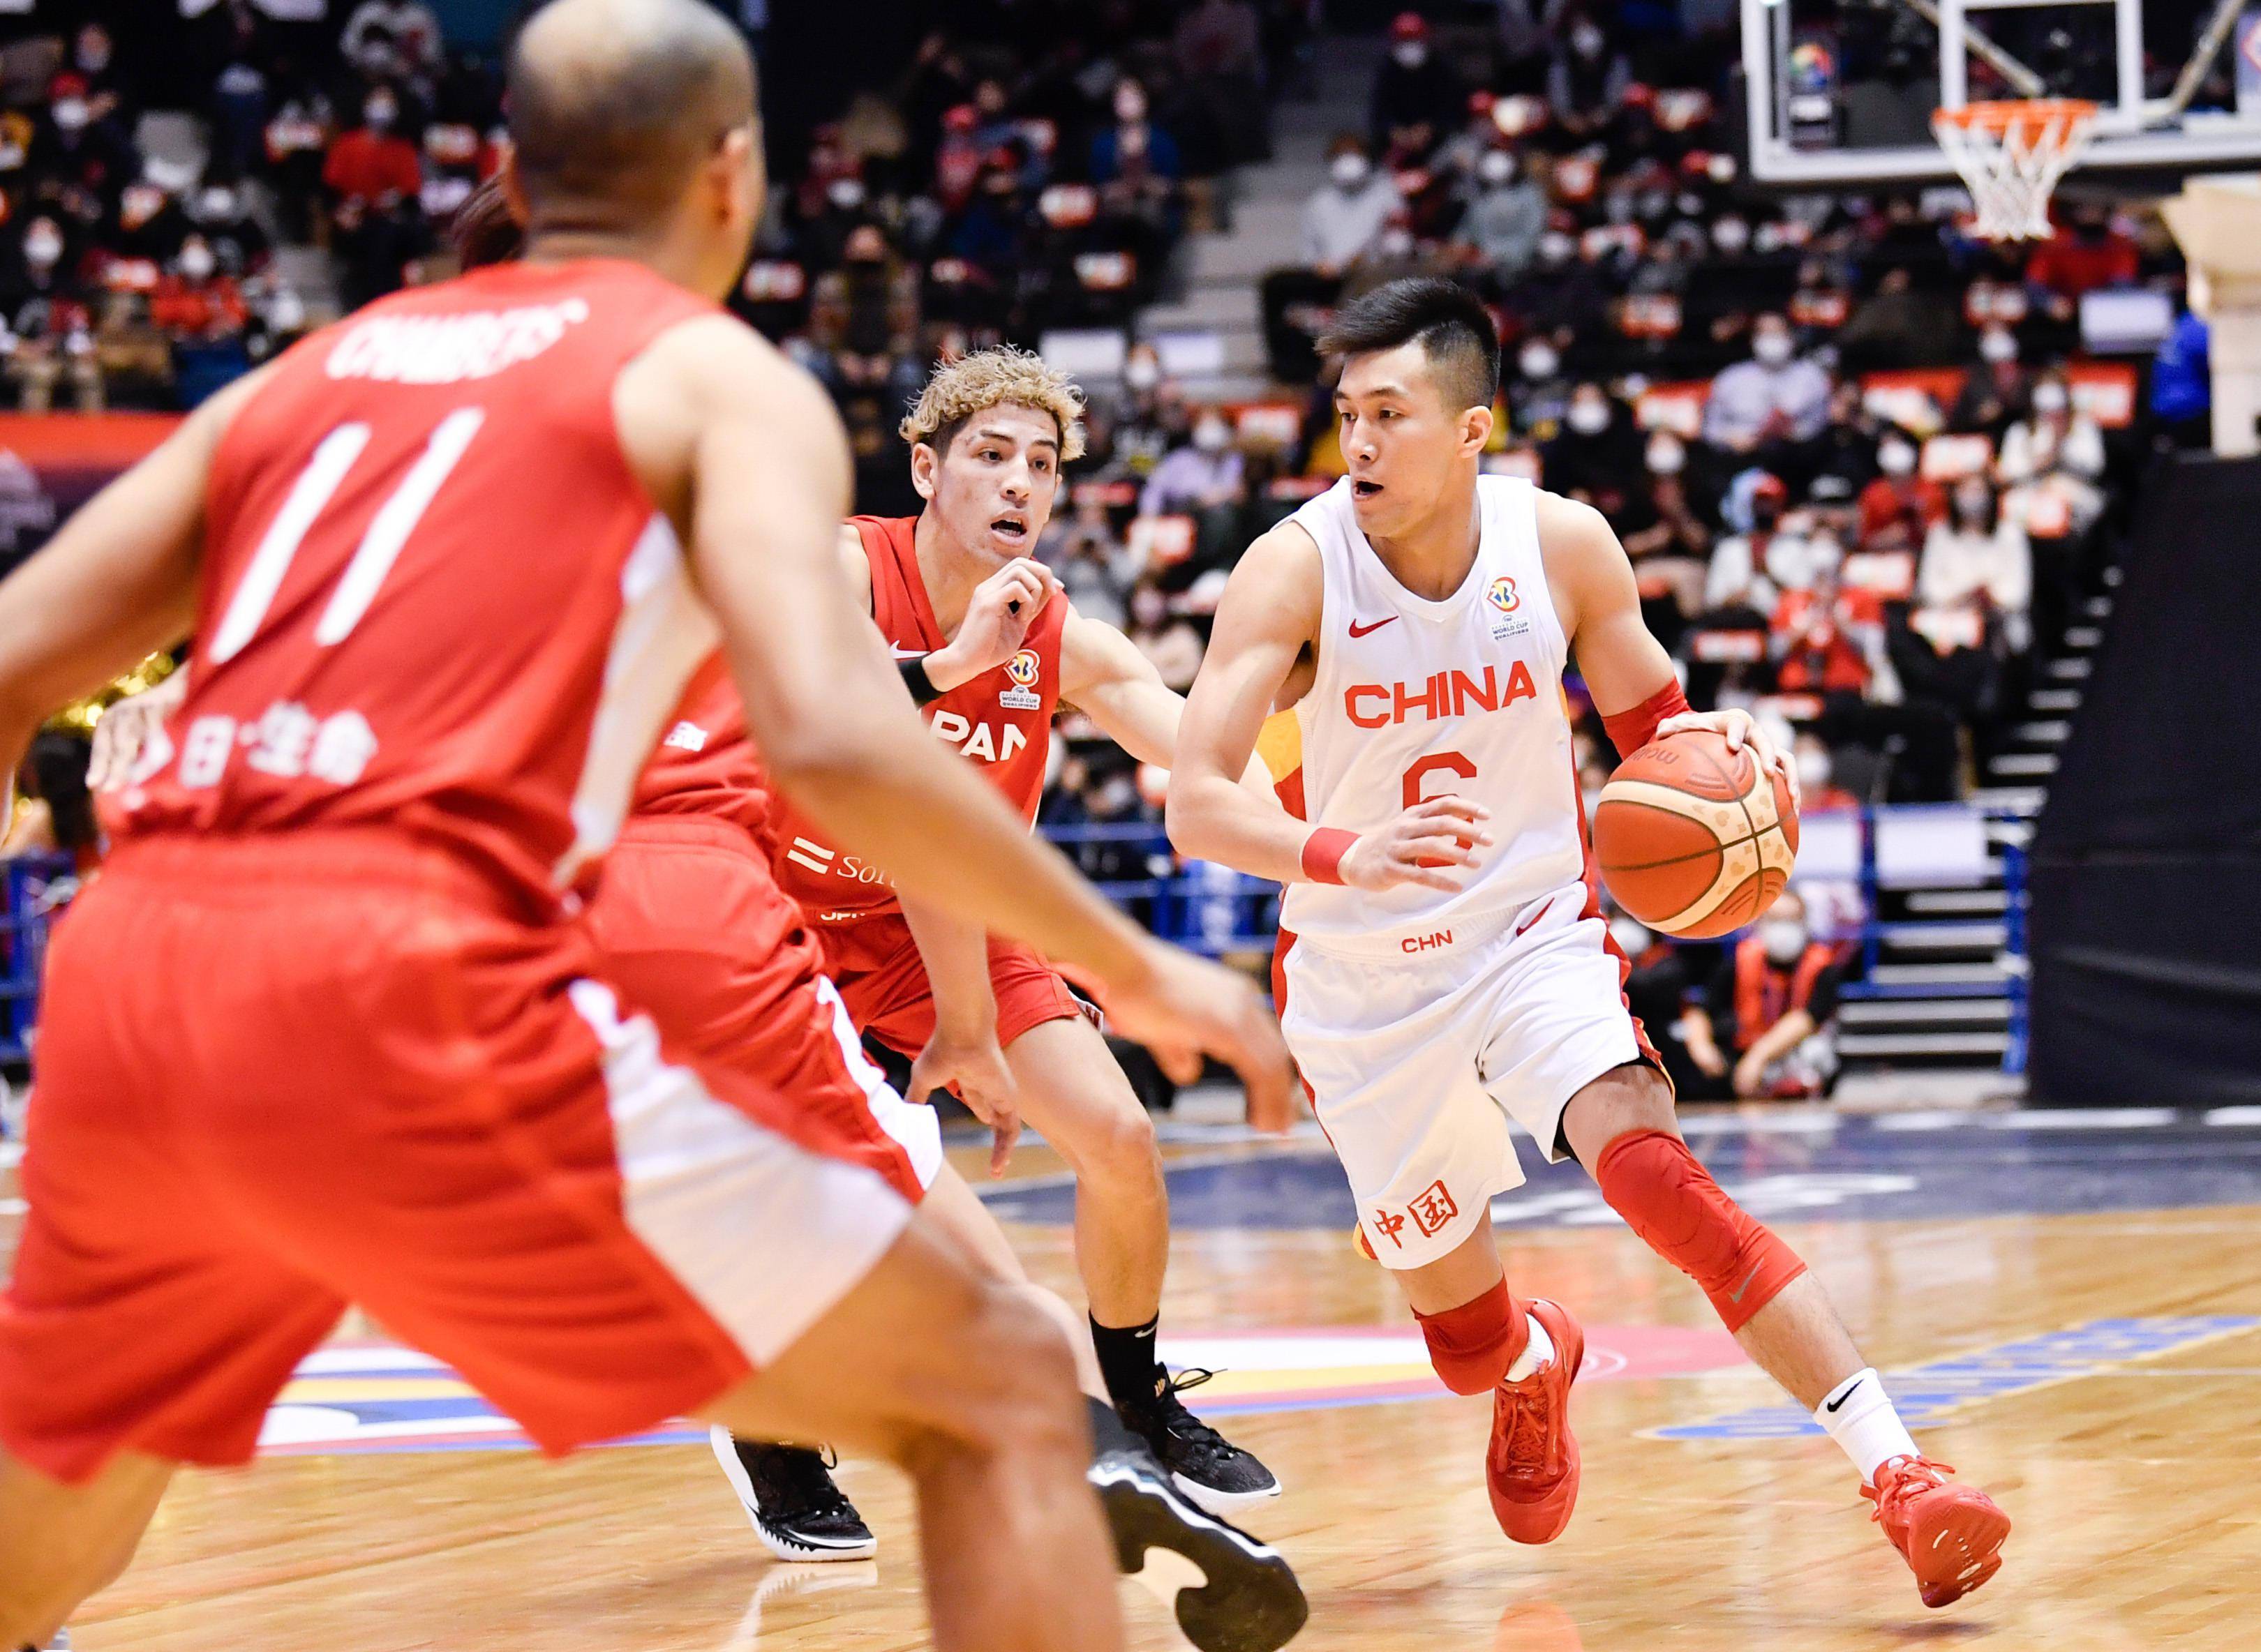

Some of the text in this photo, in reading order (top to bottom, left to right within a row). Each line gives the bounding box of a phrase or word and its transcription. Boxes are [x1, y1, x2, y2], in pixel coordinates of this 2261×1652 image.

[209, 405, 486, 665] 11
[1492, 625, 1515, 635] WORLD
[1344, 660, 1537, 728] CHINA
[929, 709, 1028, 762] PAN
[1401, 929, 1453, 954] CHN
[1373, 1179, 1458, 1250] 中国
